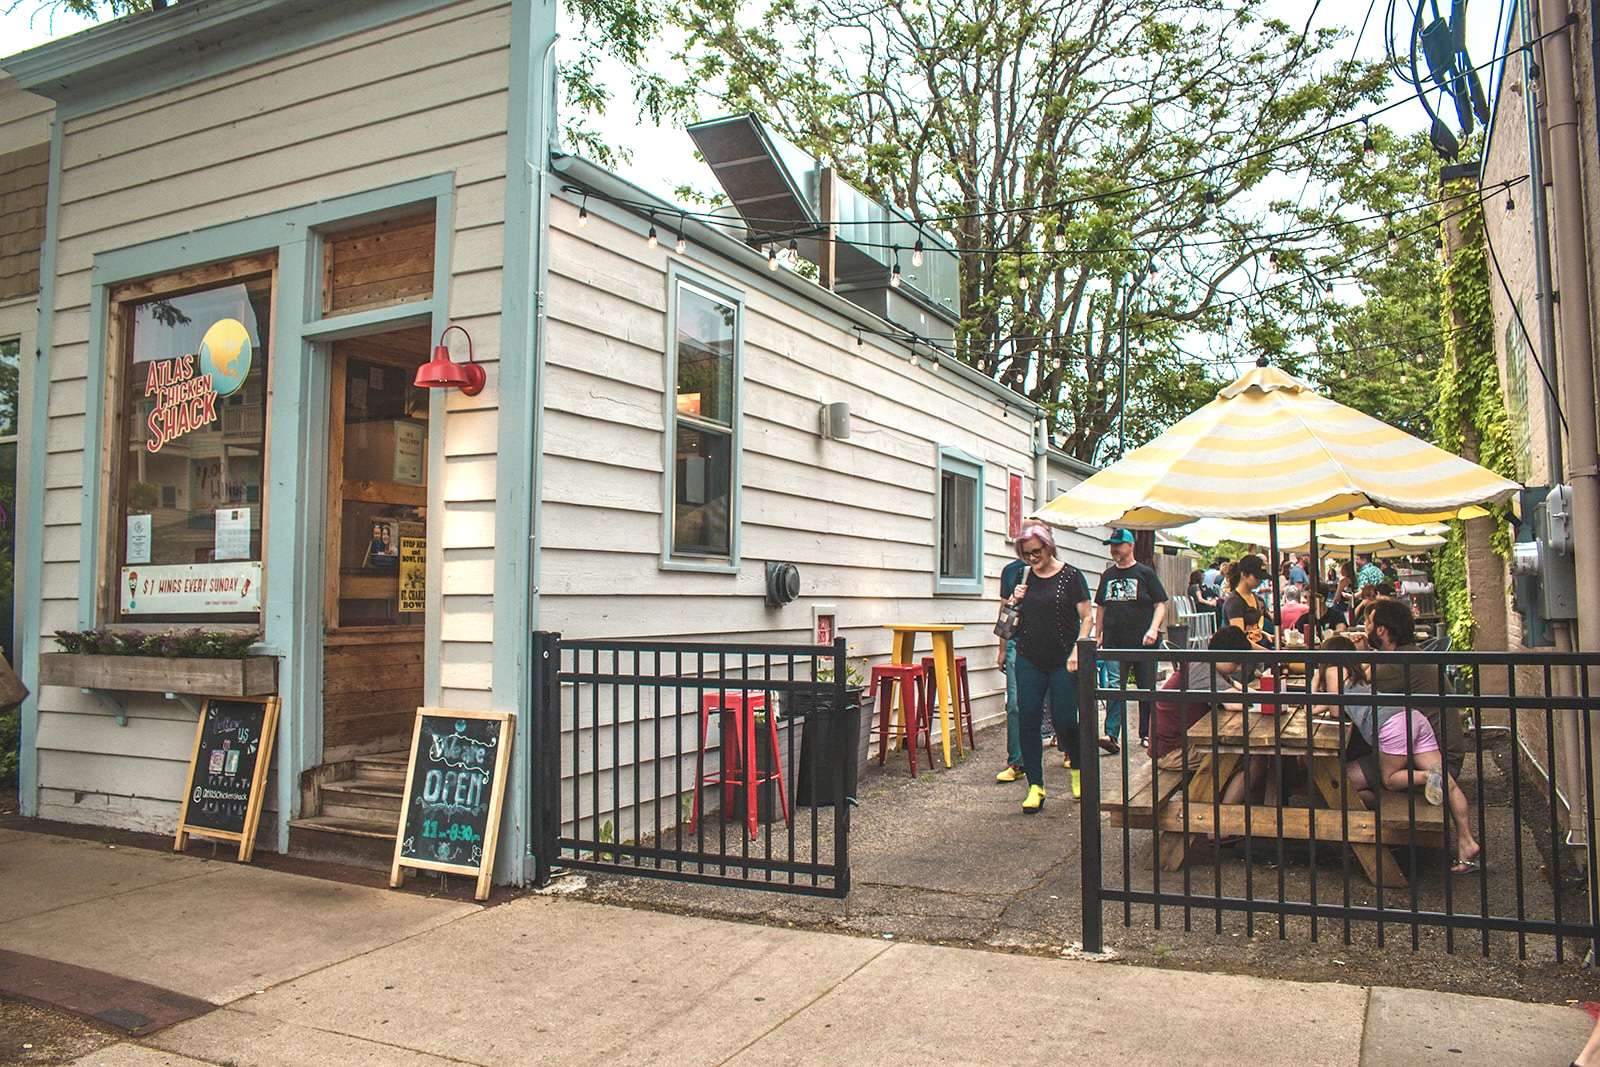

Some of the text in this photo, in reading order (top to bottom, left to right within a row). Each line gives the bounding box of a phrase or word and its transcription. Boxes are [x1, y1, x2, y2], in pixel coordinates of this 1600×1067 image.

[145, 354, 194, 397] ATLAS
[157, 372, 212, 412] CHICKEN
[147, 390, 218, 453] SHACK
[158, 579, 182, 593] WINGS
[184, 578, 208, 593] EVERY
[209, 577, 239, 592] SUNDAY
[423, 769, 482, 805] OPEN
